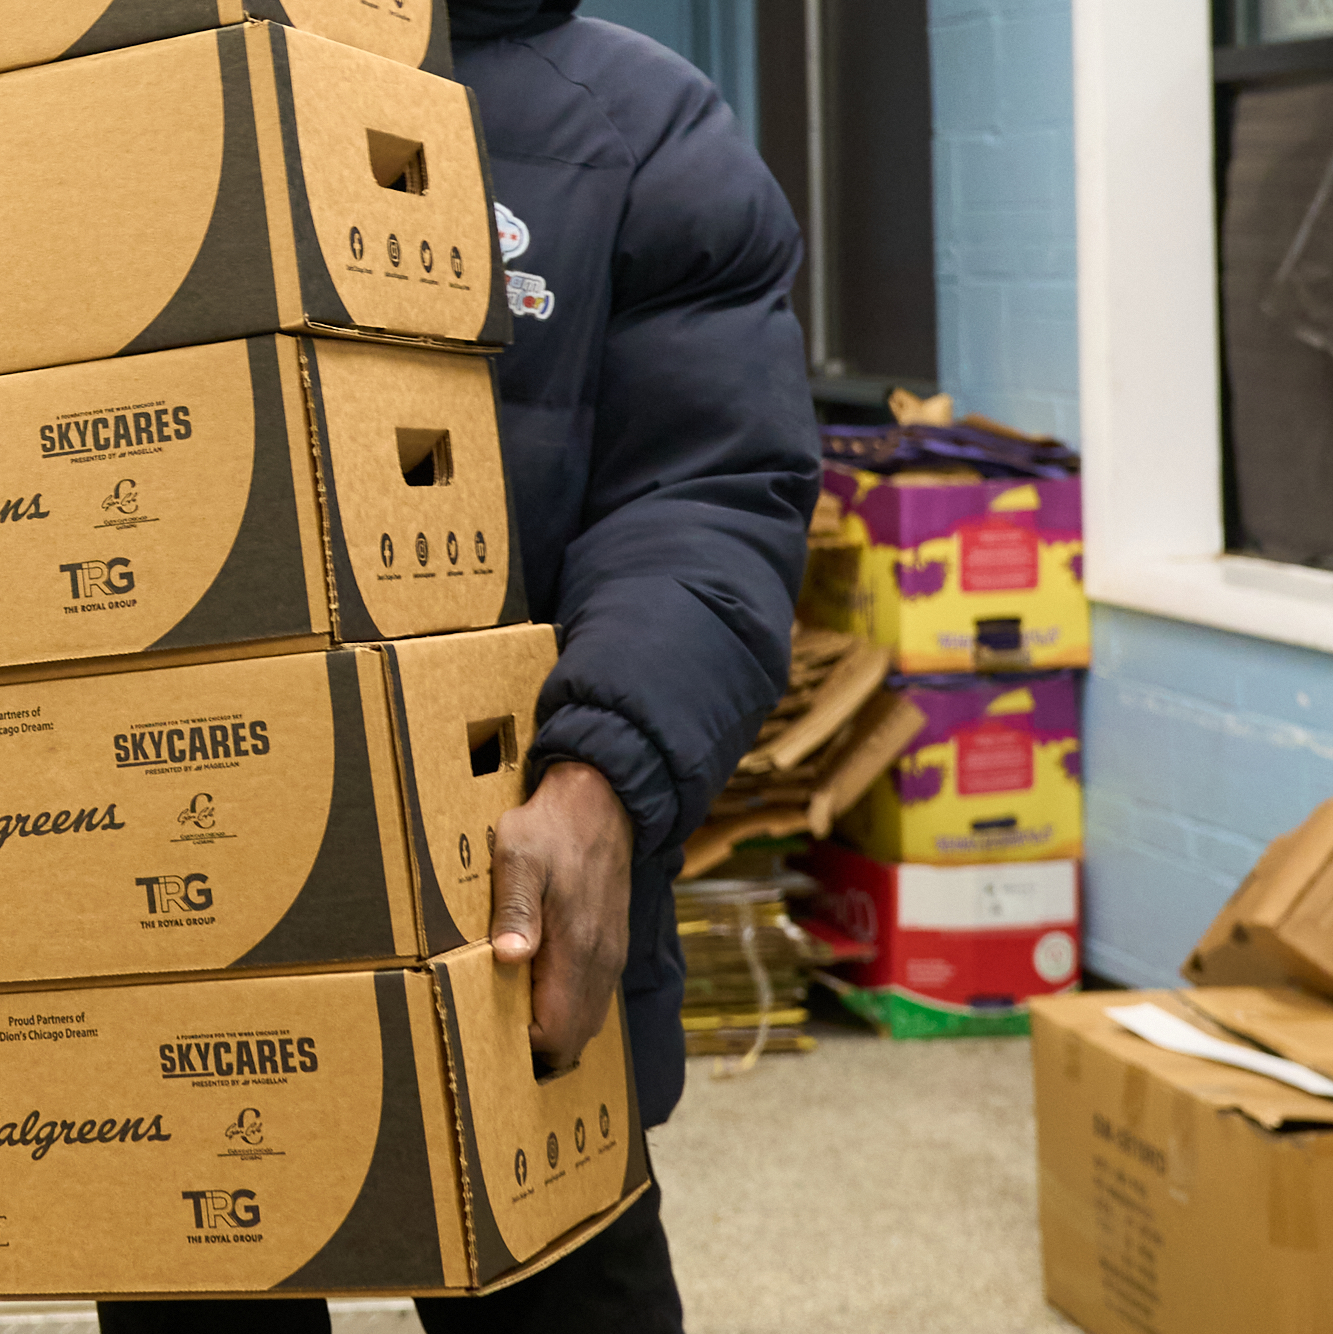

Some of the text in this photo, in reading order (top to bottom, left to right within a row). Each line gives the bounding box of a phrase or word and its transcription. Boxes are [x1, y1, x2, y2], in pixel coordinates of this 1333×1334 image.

[40, 405, 192, 453] SKYCARES
[70, 454, 106, 464] PRESENTED
[59, 557, 135, 599] TRG
[63, 599, 137, 615] THE ROYAL GROUP
[31, 706, 41, 717] of
[21, 722, 54, 733] Dream:
[114, 720, 270, 763] SKYCARES
[145, 766, 182, 775] PRESENTED
[135, 873, 214, 914] TRG
[140, 917, 216, 930] THE ROYAL GROUP
[8, 1011, 85, 1026] Proud Partners of
[0, 1028, 98, 1042] Dion's Chicago Dream:
[160, 1037, 318, 1076] SKYCARES
[192, 1079, 229, 1087] PRESENTED
[181, 1189, 261, 1229] TRG
[187, 1234, 263, 1244] THE ROYAL GROUP
